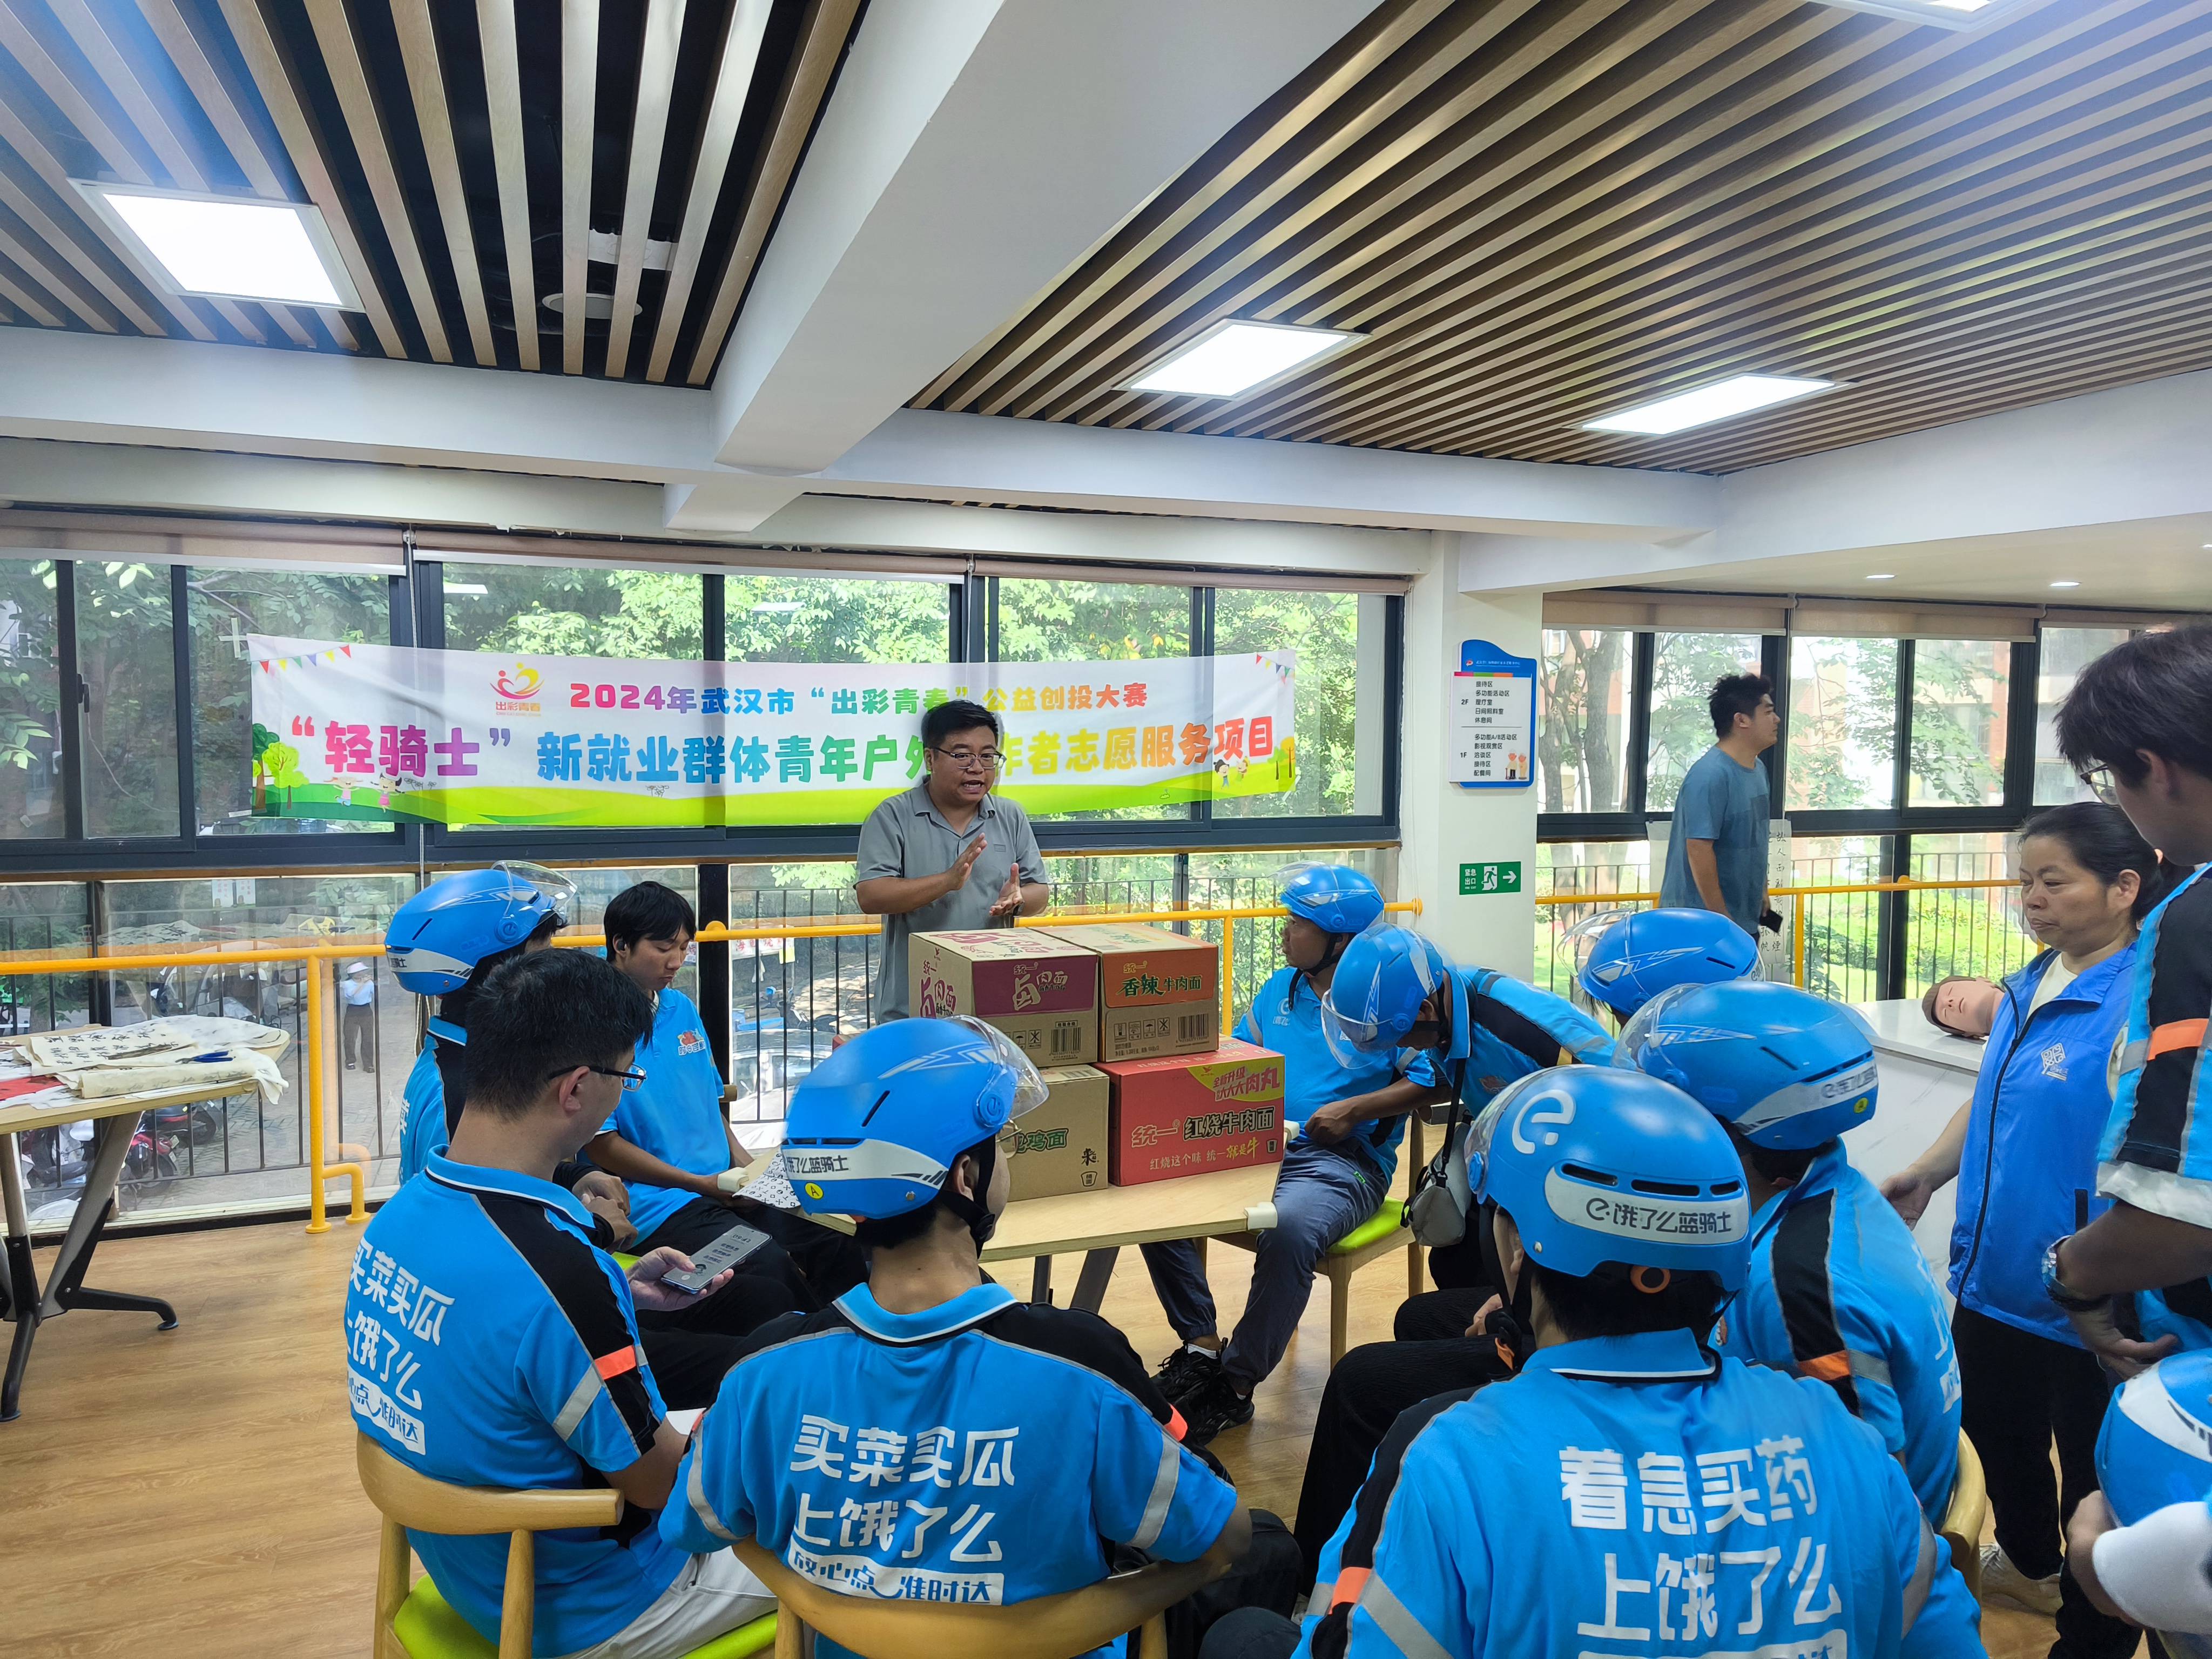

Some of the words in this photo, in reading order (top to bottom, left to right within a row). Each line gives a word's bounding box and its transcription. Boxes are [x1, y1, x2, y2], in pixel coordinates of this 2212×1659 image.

[1465, 868, 1477, 876] 紧急
[1465, 877, 1476, 885] 出口
[923, 960, 936, 975] 统一
[1014, 963, 1037, 975] 统一
[1123, 962, 1146, 974] 统一
[1116, 973, 1203, 998] 香辣牛肉面
[1213, 1066, 1245, 1088] 全新升级
[1183, 1106, 1275, 1142] 红烧牛肉面
[1149, 1152, 1202, 1170] 红烧这个味
[810, 1185, 820, 1196] A
[1613, 1203, 1732, 1234] 饿了么蓝骑士
[349, 1235, 456, 1346] 买菜买瓜
[347, 1300, 422, 1411] 饿了么
[790, 1414, 1020, 1488] 买菜买瓜
[1559, 1434, 1818, 1536] 着急买药
[793, 1493, 1003, 1562] 上饿了么
[900, 1574, 993, 1603] 准时达
[1576, 1536, 1842, 1642] 上饿了么
